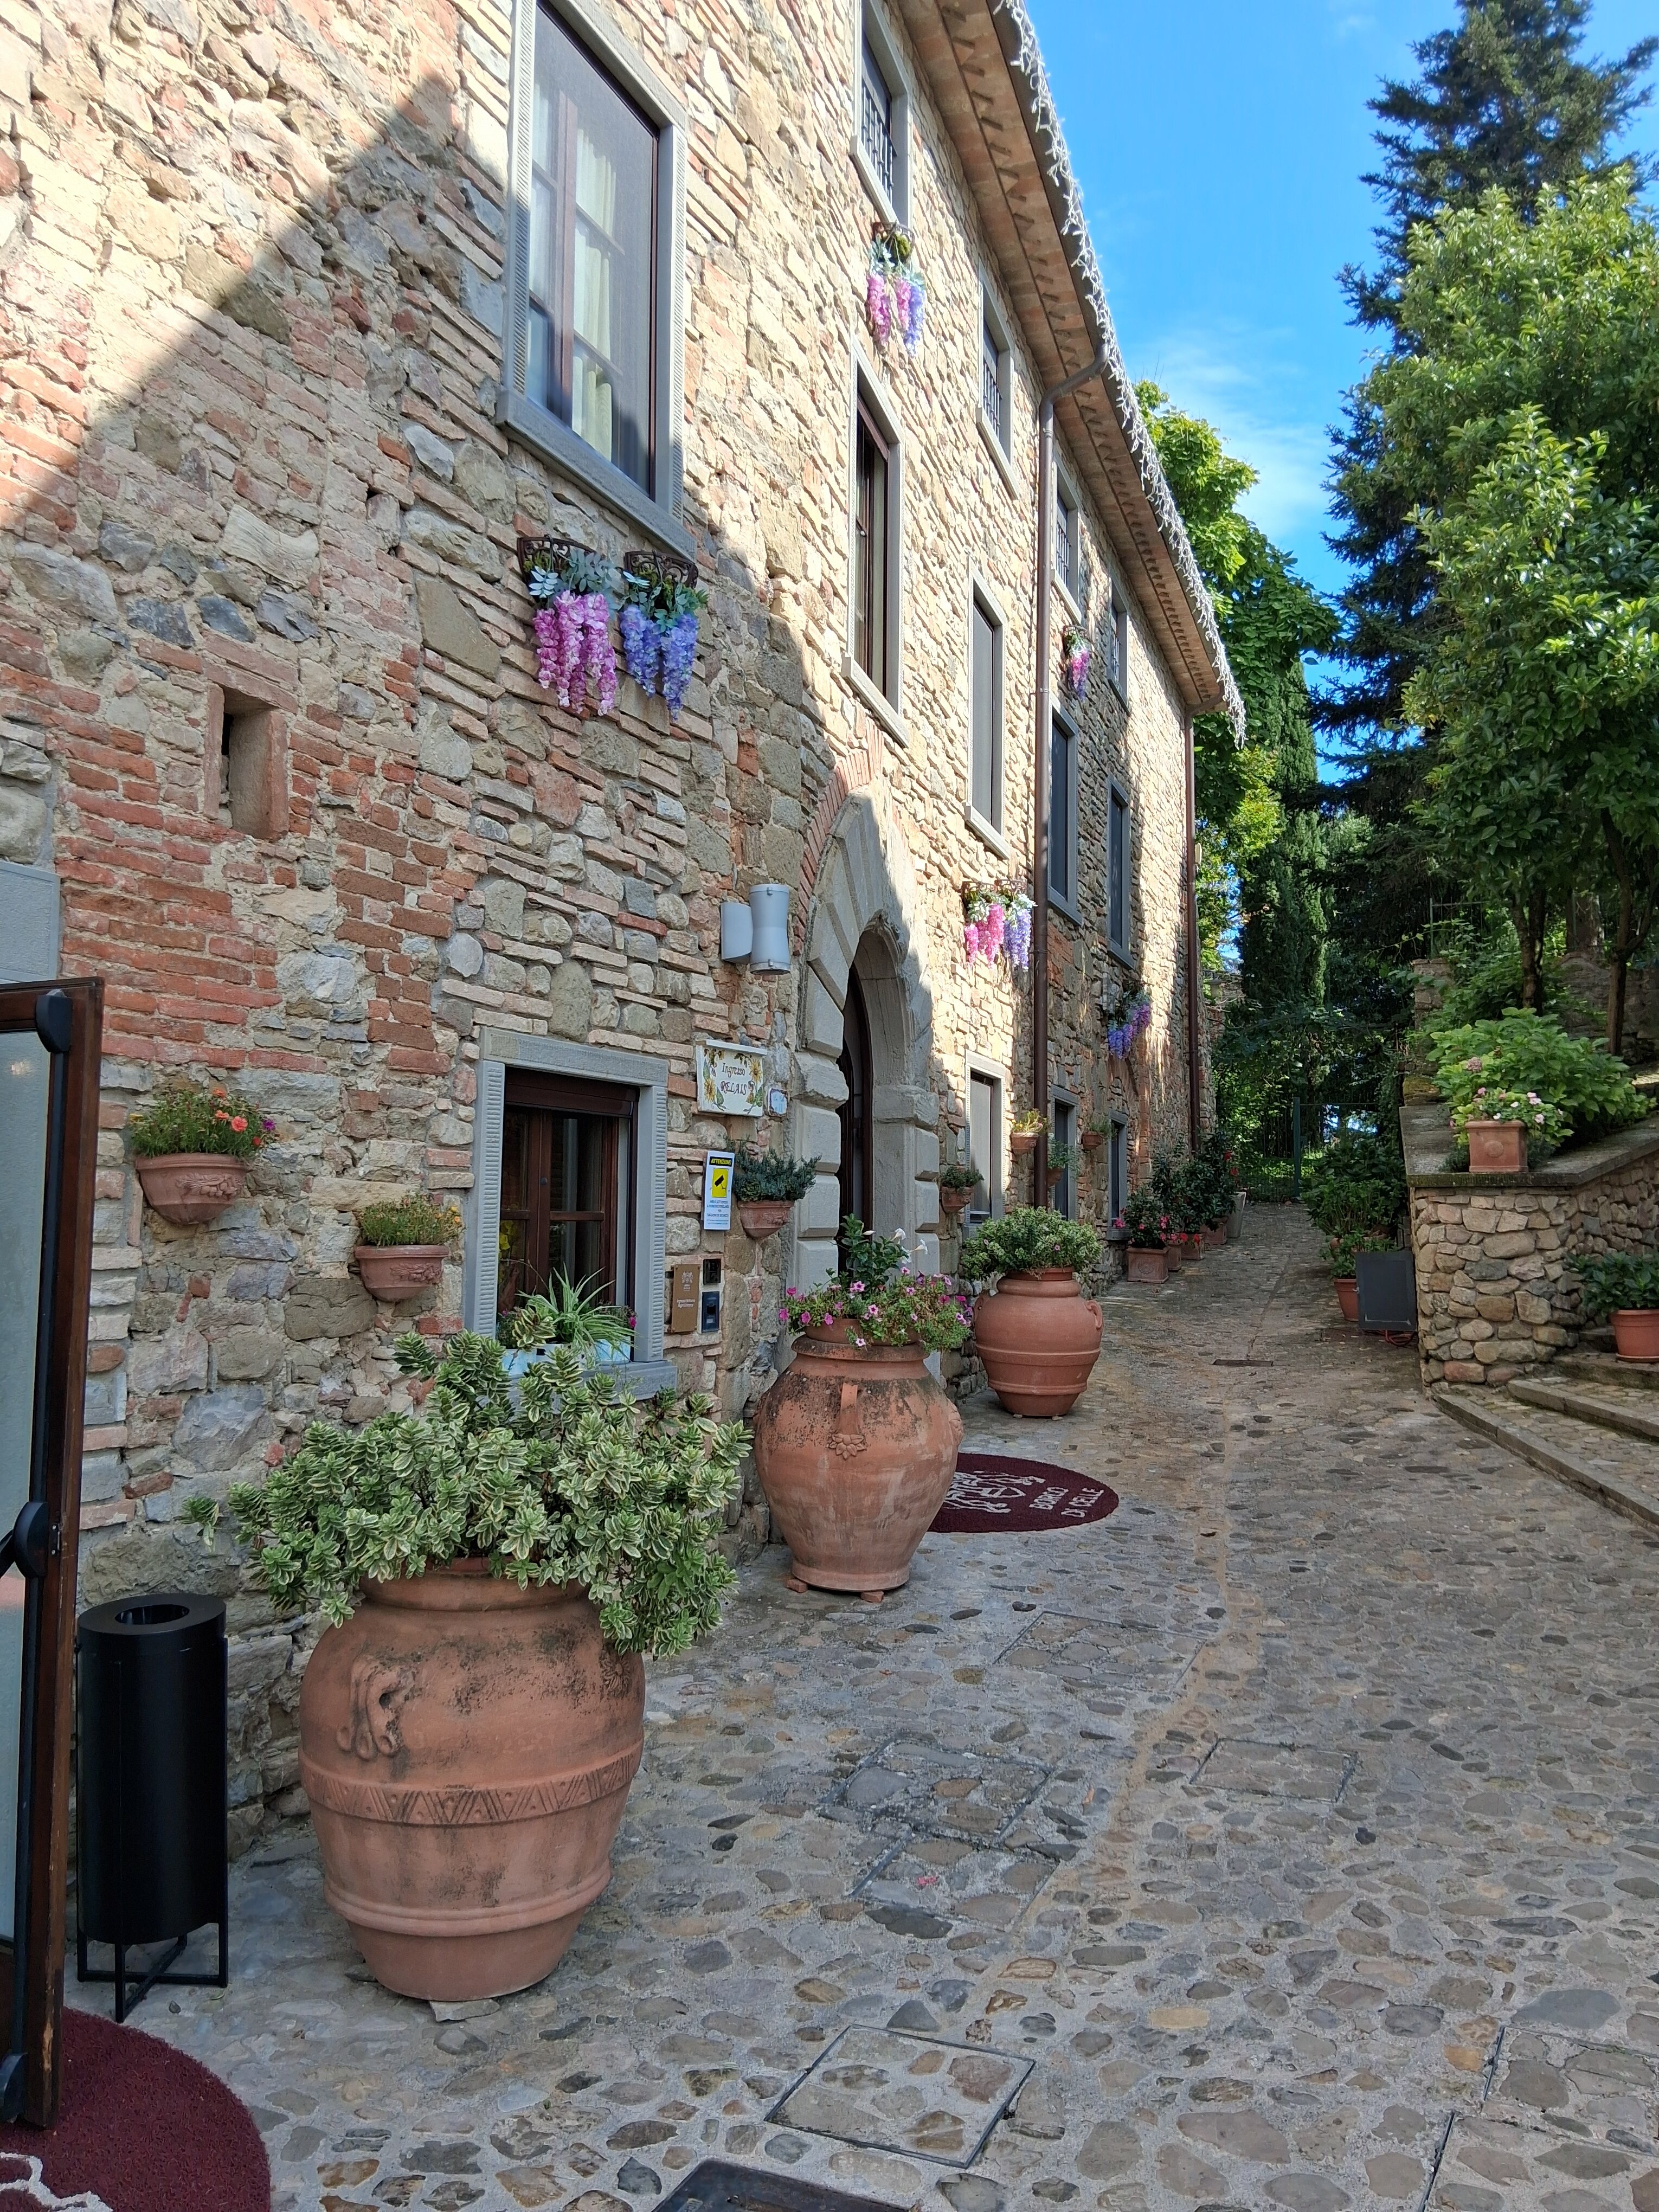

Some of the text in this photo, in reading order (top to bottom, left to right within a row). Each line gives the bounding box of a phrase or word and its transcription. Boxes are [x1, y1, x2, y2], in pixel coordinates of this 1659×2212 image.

[722, 1062, 745, 1078] Ingresso
[720, 1081, 747, 1095] RELAIS
[1029, 1487, 1069, 1510] BORGO
[1060, 1488, 1104, 1518] DI CELLE
